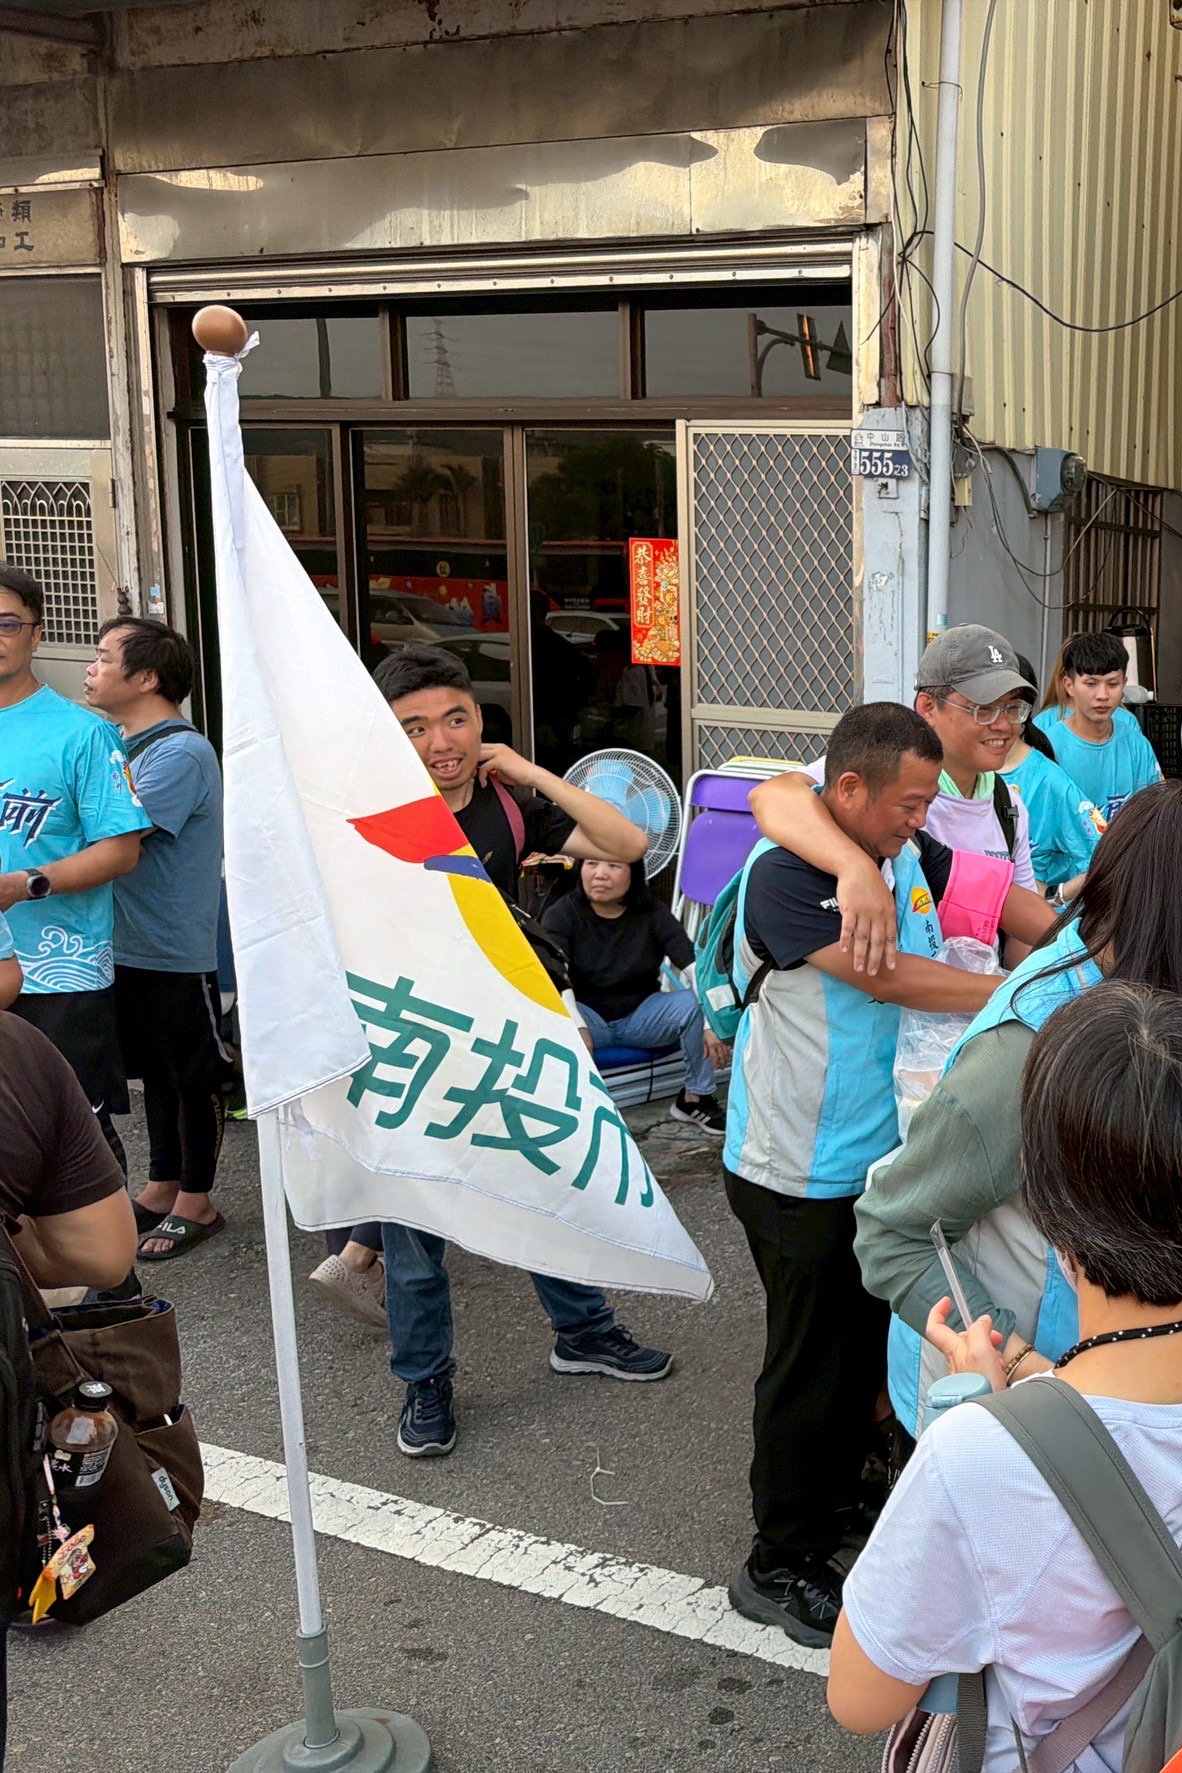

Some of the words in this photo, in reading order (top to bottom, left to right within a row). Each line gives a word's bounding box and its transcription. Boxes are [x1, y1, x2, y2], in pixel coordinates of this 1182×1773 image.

[634, 544, 653, 625] 恭喜發財
[988, 645, 1003, 663] LA
[925, 920, 940, 957] 南投
[159, 1475, 174, 1502] dyson
